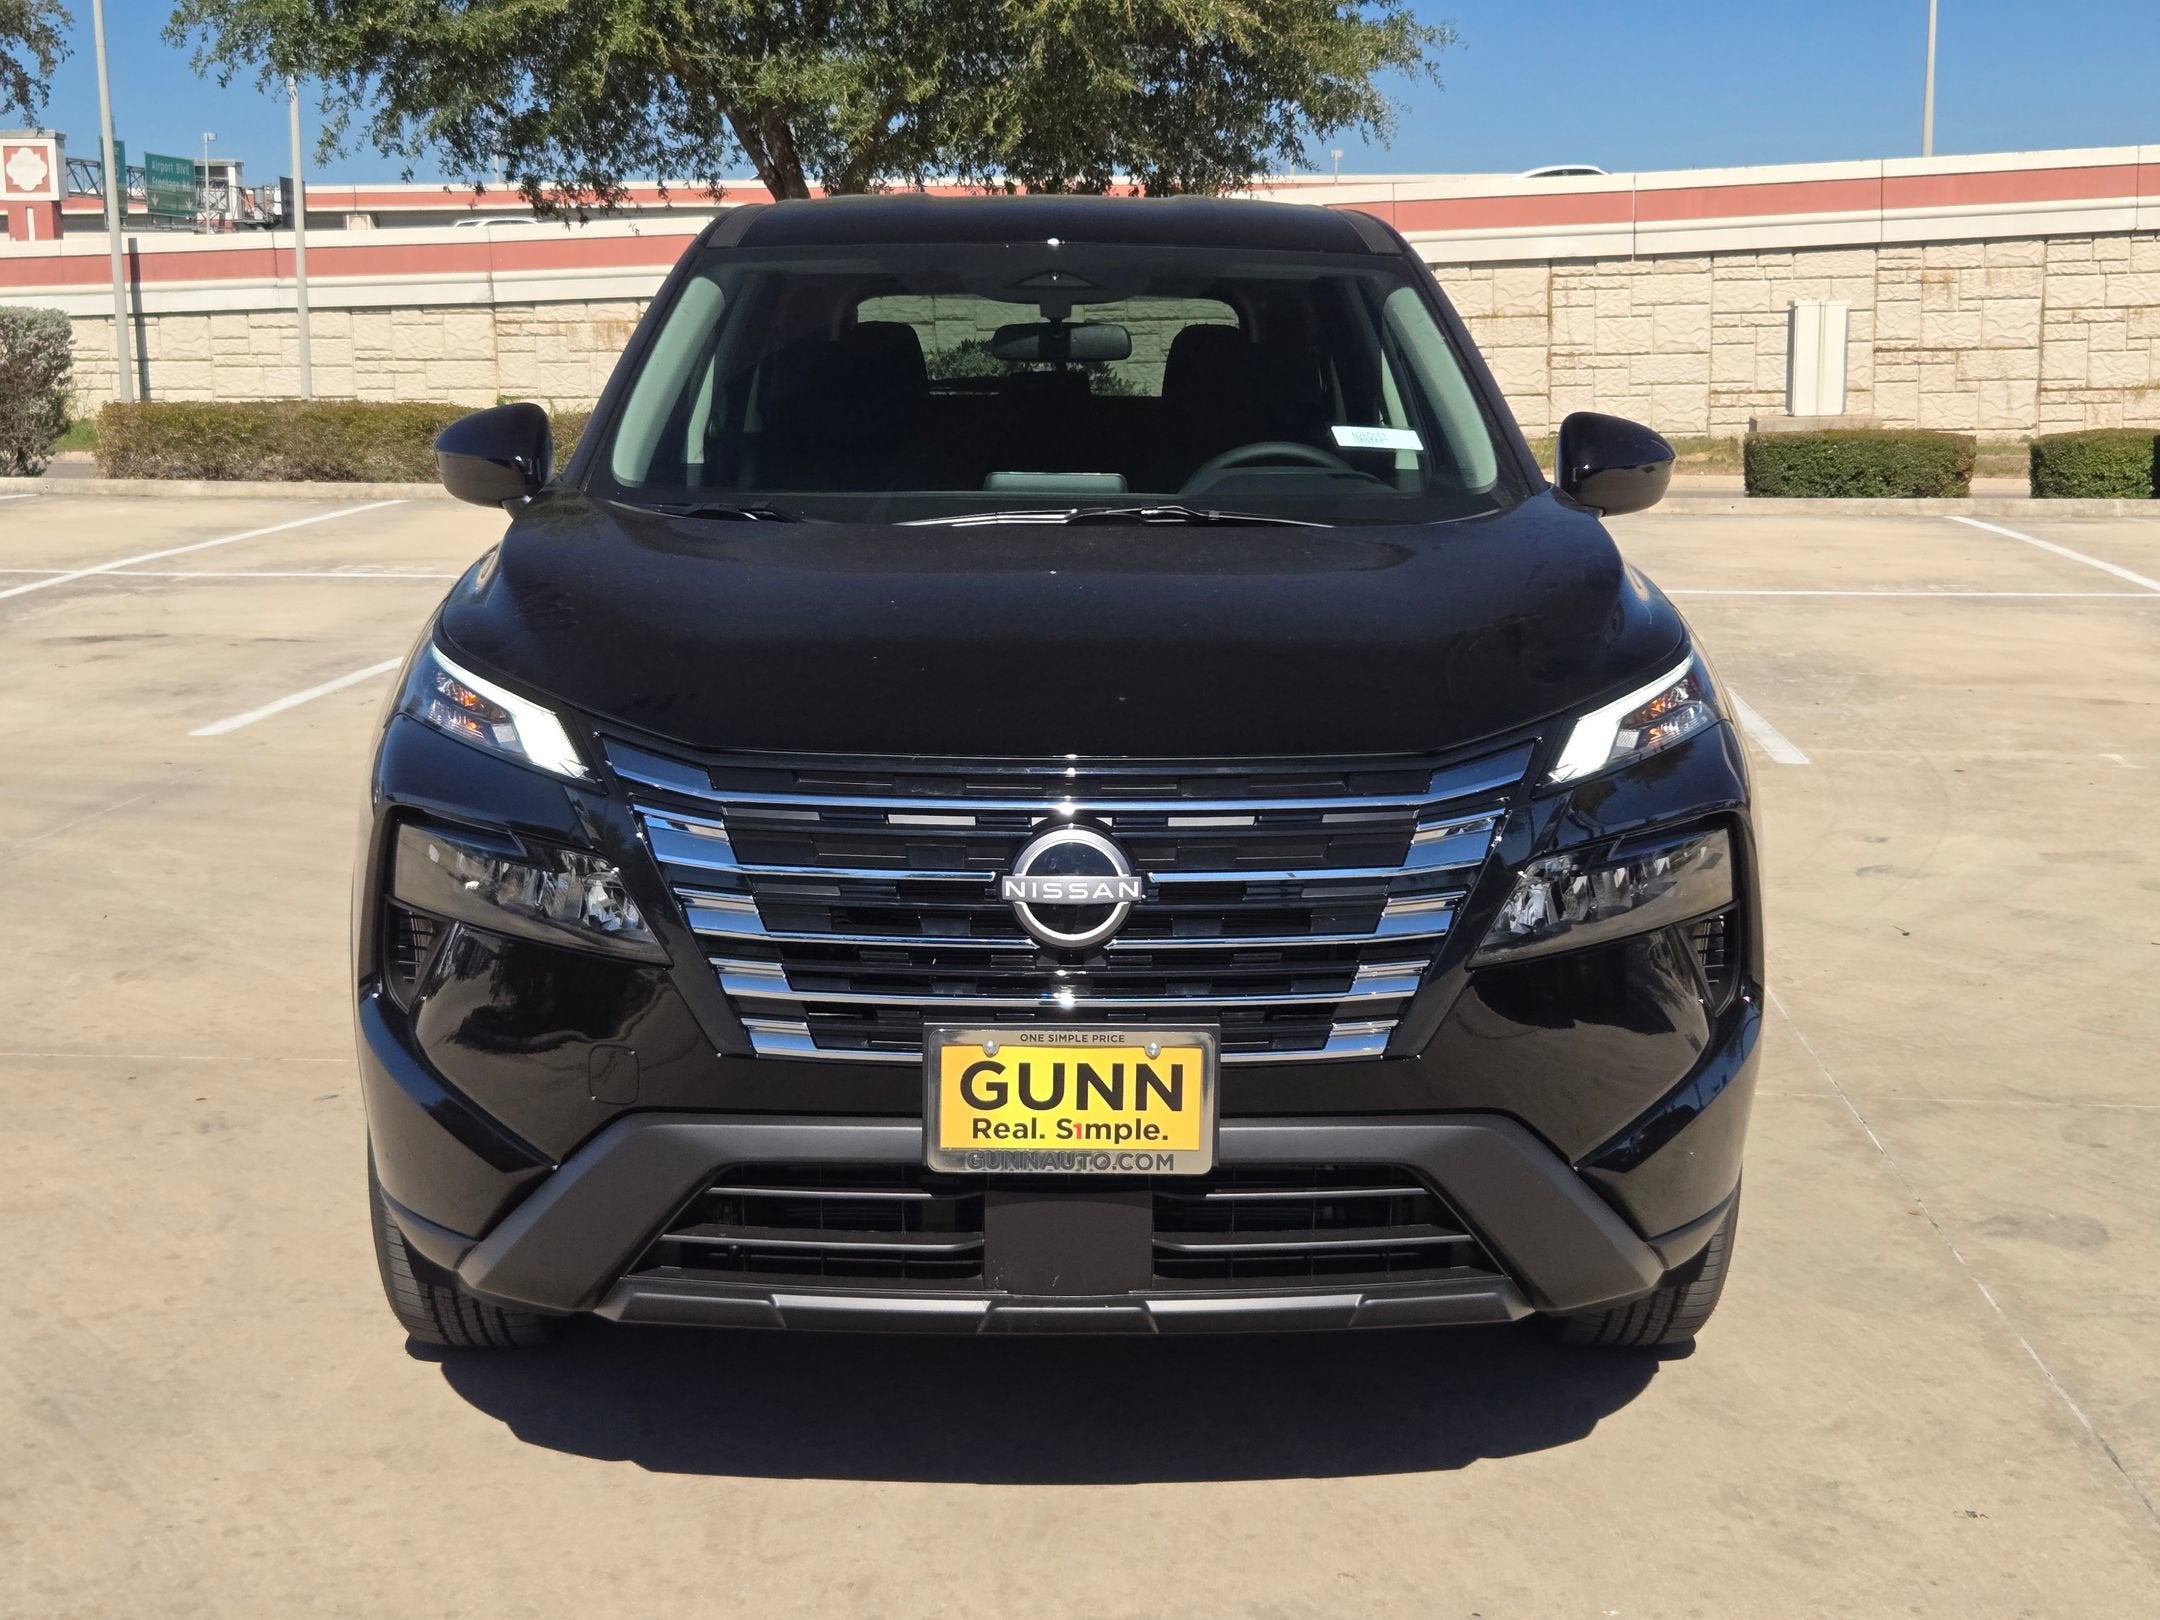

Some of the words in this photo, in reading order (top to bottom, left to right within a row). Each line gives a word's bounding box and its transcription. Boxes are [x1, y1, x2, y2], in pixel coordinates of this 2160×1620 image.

[152, 160, 173, 173] Airport
[1005, 880, 1139, 899] NISSAN
[1020, 1033, 1044, 1043] ONE
[1047, 1033, 1089, 1043] SIMPLE
[1092, 1034, 1125, 1043] PRICE
[960, 1060, 1183, 1111] GUNN
[972, 1117, 1045, 1140] Real.
[967, 1151, 1174, 1171] GUNNAUTO.COM
